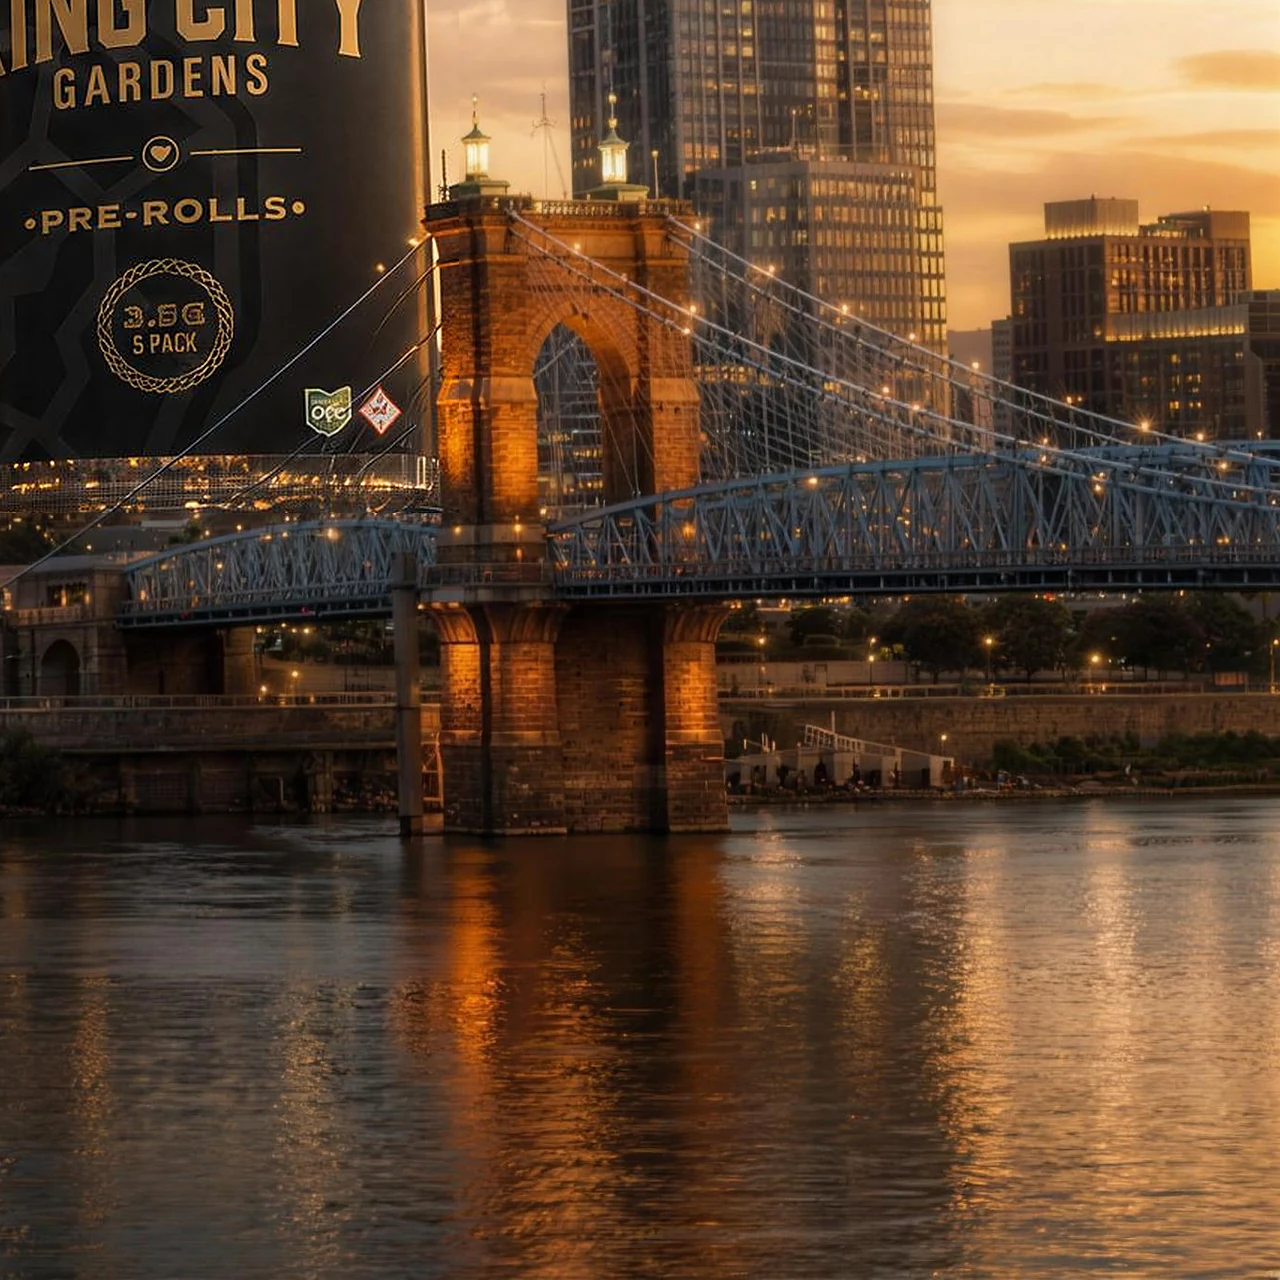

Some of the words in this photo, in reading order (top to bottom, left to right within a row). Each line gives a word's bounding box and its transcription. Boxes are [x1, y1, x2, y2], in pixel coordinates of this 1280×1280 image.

[53, 53, 270, 110] GARDENS
[41, 196, 288, 235] PRE-ROLLS
[149, 331, 197, 353] PACK
